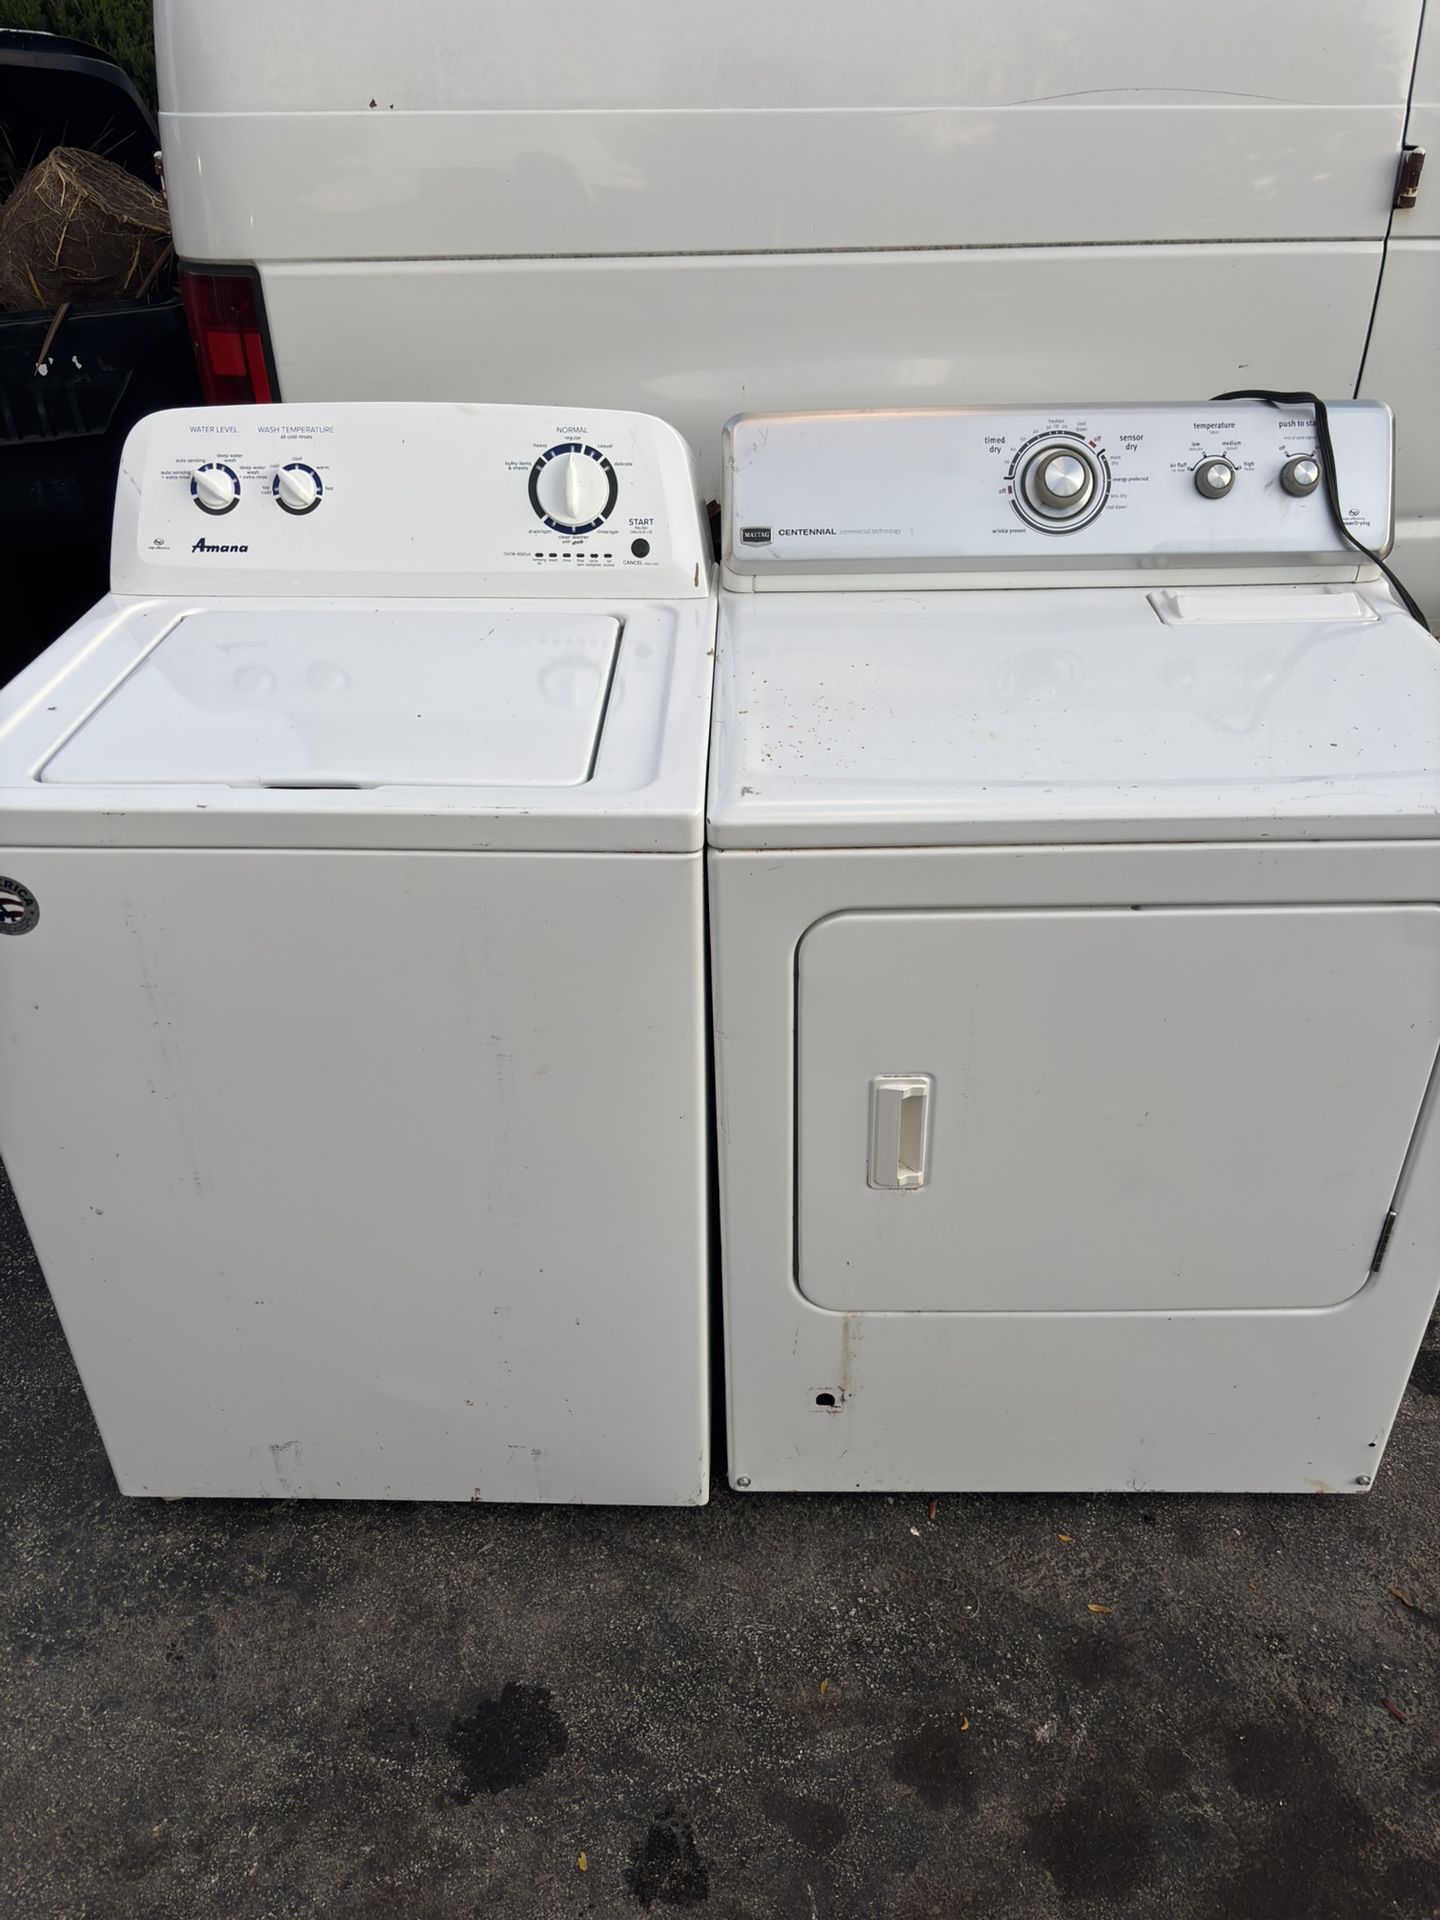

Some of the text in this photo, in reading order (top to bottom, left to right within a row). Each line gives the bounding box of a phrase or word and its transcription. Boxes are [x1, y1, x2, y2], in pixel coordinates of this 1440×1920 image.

[1193, 422, 1235, 430] temperature
[1279, 420, 1295, 429] push
[984, 436, 1005, 444] timed
[990, 446, 1001, 454] dry
[1125, 443, 1137, 452] dry
[779, 528, 836, 536] CENTENNIAL
[192, 537, 248, 553] Amana
